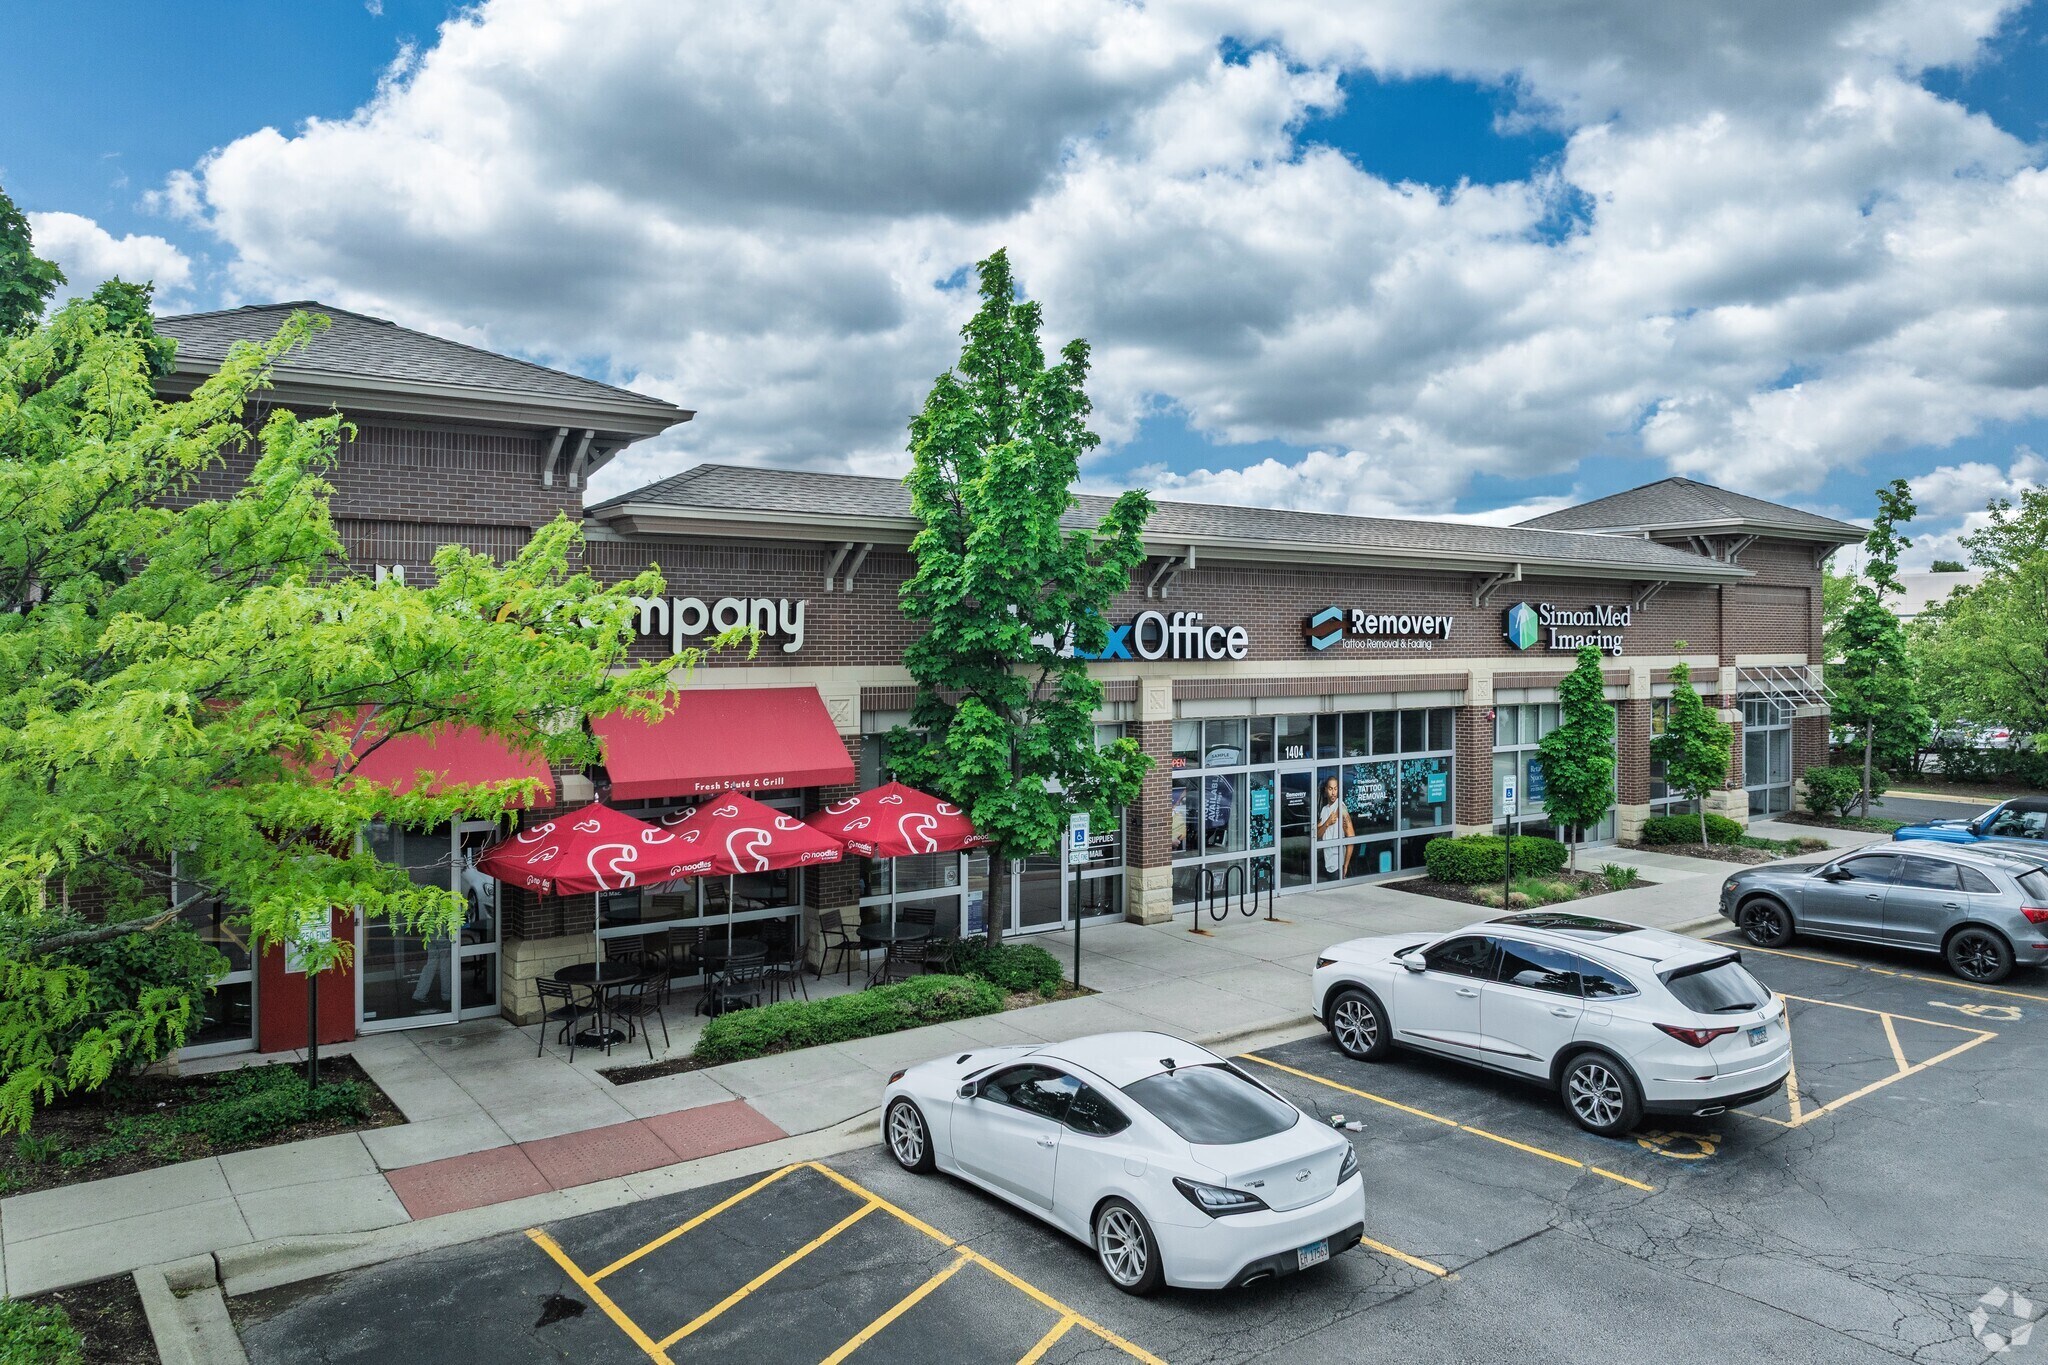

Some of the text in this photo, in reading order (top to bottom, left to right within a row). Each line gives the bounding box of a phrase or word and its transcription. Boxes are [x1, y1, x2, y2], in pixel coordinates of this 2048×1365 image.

[1540, 602, 1631, 627] SimonMed
[580, 597, 805, 654] mpany
[1351, 608, 1453, 640] Removery
[1342, 638, 1432, 651] Tattoo Removal & Fading
[1285, 745, 1304, 759] 1404
[1171, 758, 1186, 768] PEN
[694, 781, 721, 791] Fresh
[754, 778, 760, 788] &
[763, 777, 784, 787] Grill
[1357, 783, 1382, 792] TATTOO
[1208, 777, 1219, 822] AVAILABL
[1357, 791, 1388, 801] REMOVAL
[973, 832, 989, 841] nood
[1088, 834, 1114, 844] SUPPLIES
[812, 849, 838, 858] noodles
[1089, 849, 1104, 858] MAIL
[682, 860, 712, 872] noodles
